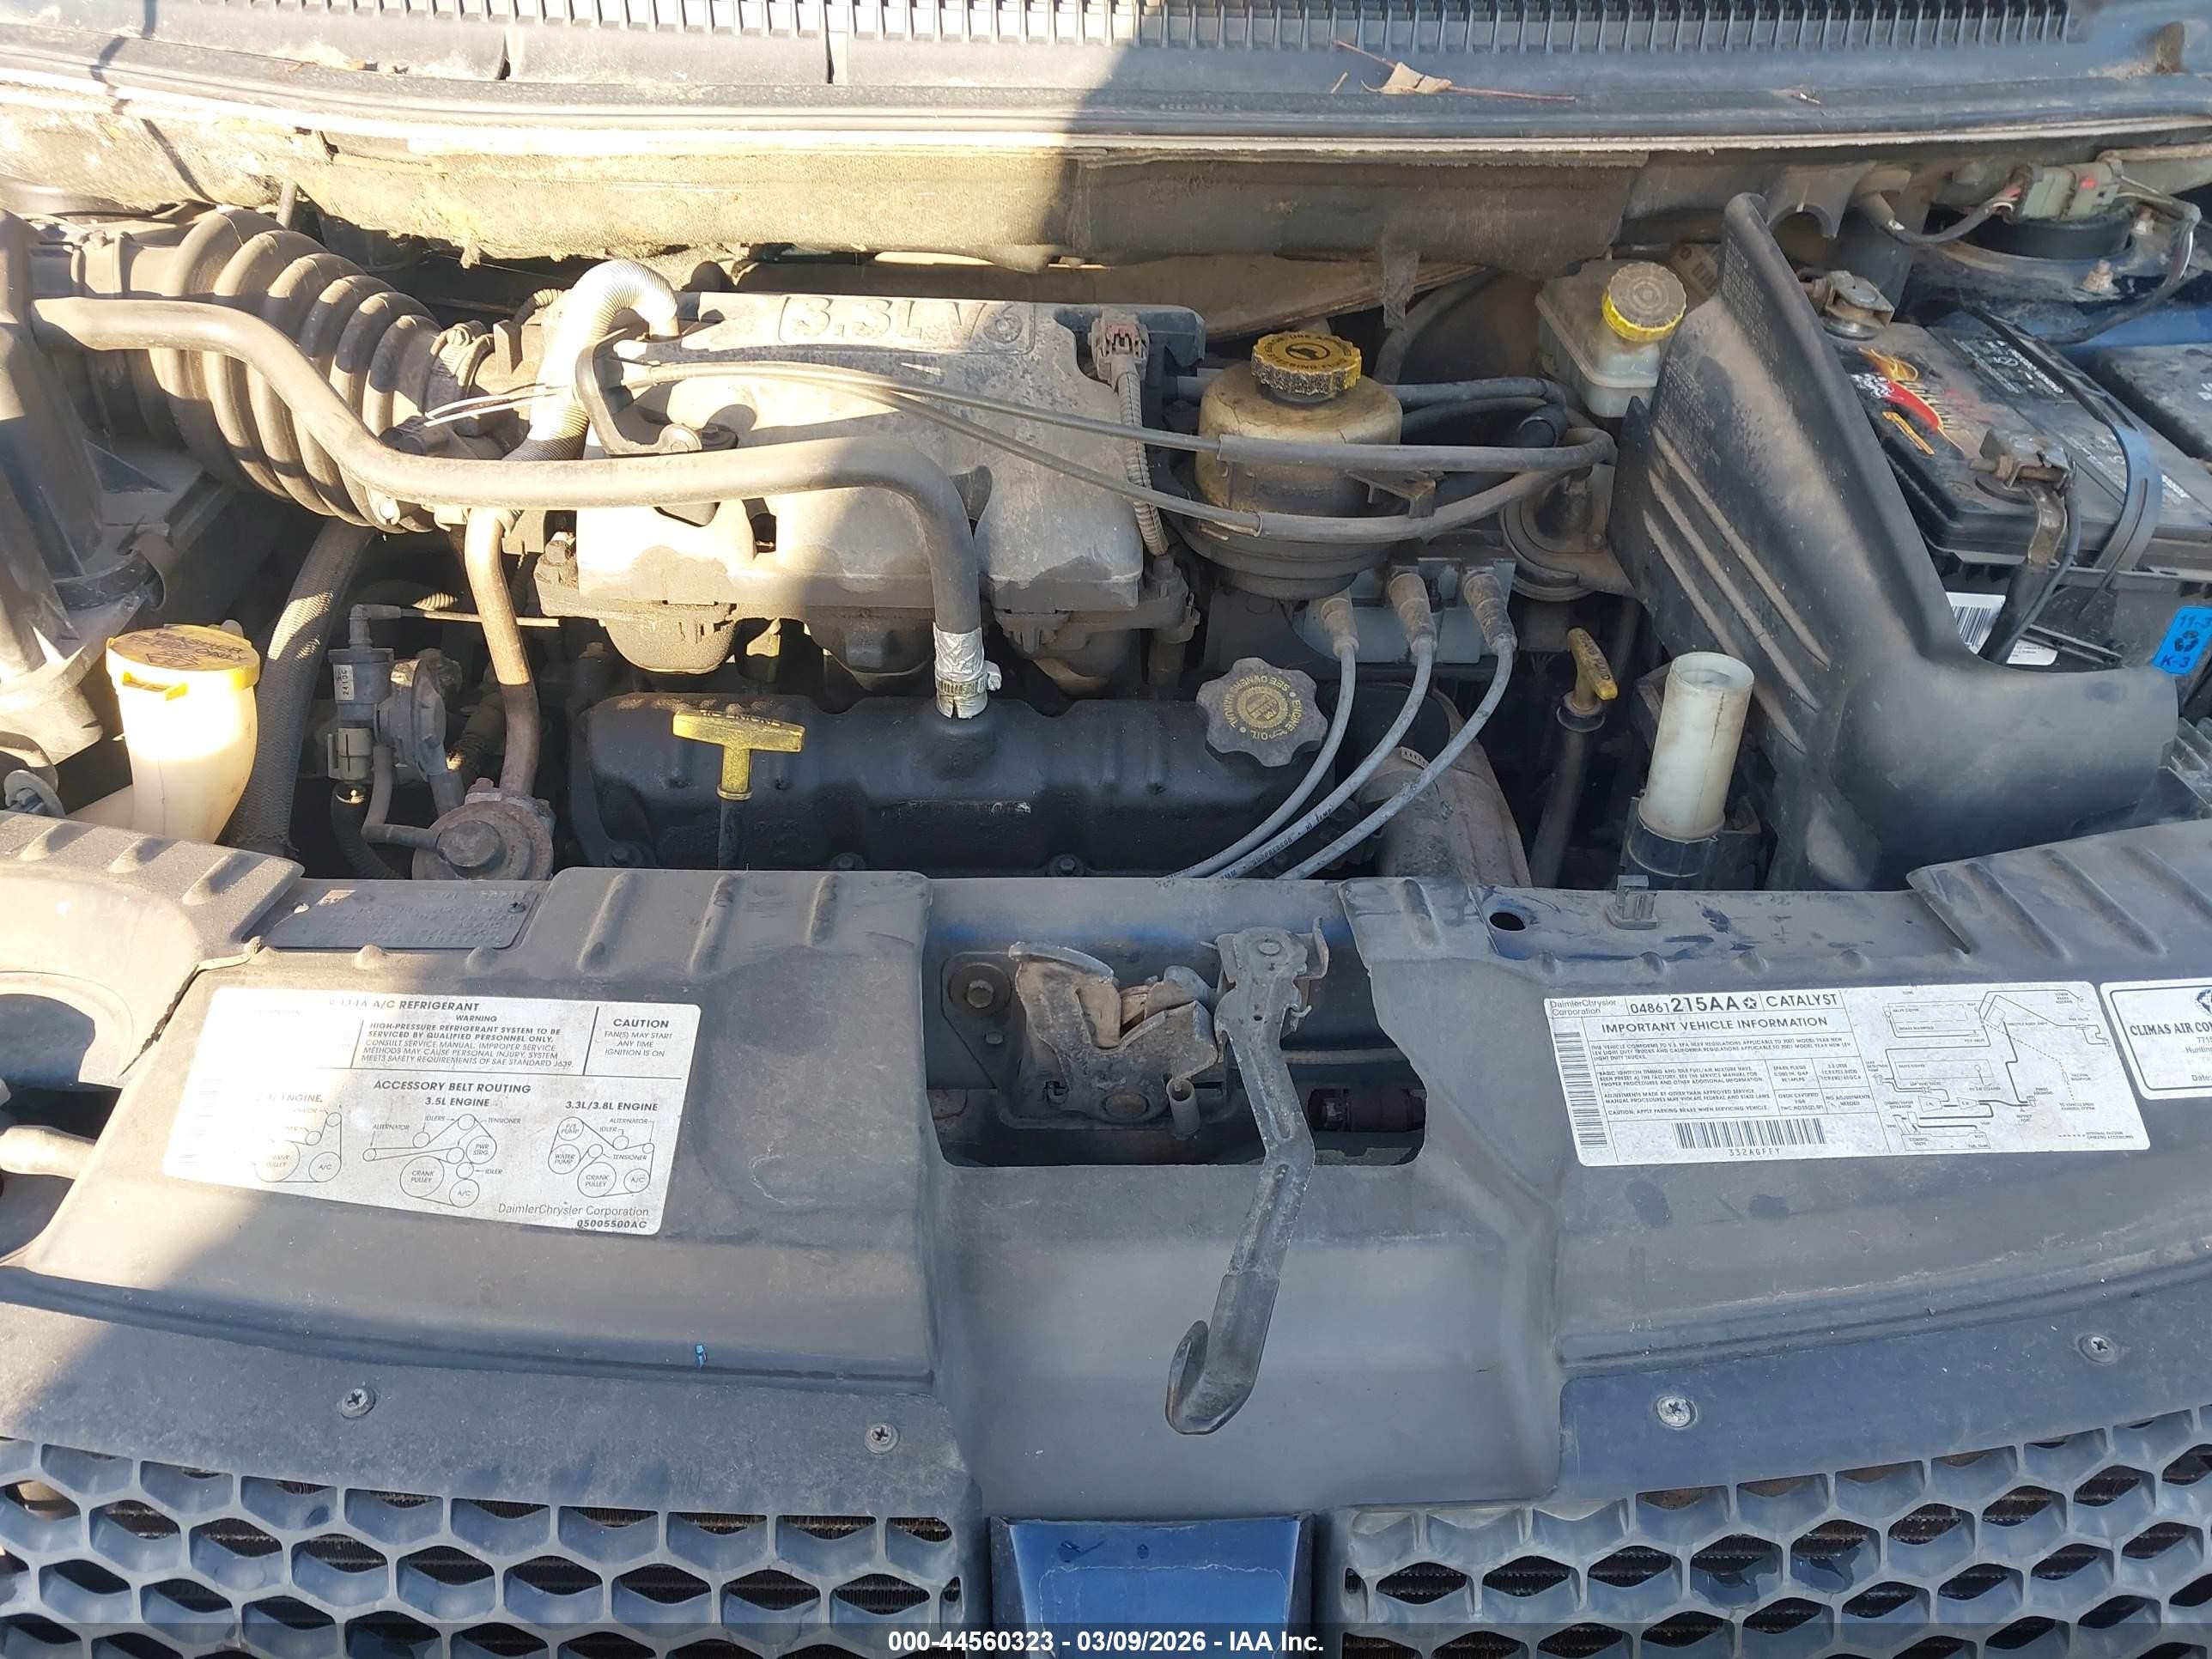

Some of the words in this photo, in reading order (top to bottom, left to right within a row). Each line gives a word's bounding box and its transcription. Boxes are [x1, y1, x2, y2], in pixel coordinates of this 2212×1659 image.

[945, 301, 1024, 344] V6
[2160, 654, 2191, 668] K-3
[1269, 677, 1290, 691] SEE
[1223, 693, 1238, 728] MANUAL
[1285, 700, 1303, 732] ENGINE
[1250, 729, 1268, 741] OIL
[373, 1000, 396, 1009] A/C
[398, 1000, 480, 1012] REFRIGERANT
[1550, 999, 1617, 1009] DaimlerChrysler
[1765, 994, 1838, 1007] CATALYST
[1552, 1006, 1601, 1017] Corporation
[456, 1014, 497, 1023] WARNING
[613, 1018, 670, 1029] CAUTION
[369, 1023, 436, 1031] HIGH-PRESSURE
[439, 1024, 499, 1033] REFRIGERANT
[1601, 1022, 1676, 1033] IMPORTANT
[1680, 1020, 1735, 1030] VEHICLE
[1737, 1017, 1828, 1030] INFORMATION
[2130, 1024, 2171, 1036] CLIMAS
[2174, 1023, 2194, 1034] AIR
[475, 1034, 526, 1042] PERSONNEL
[604, 1030, 629, 1040] FAN(S)
[479, 1042, 521, 1051] IMPROPER
[605, 1048, 642, 1057] IGNITION
[416, 1055, 477, 1064] REQUIREMENTS
[373, 1079, 446, 1091] ACCESSORY
[448, 1081, 474, 1092] BELT
[477, 1082, 532, 1094] ROUTING
[425, 1097, 447, 1106] 3.5L
[450, 1097, 490, 1107] ENGINE
[565, 1101, 614, 1110] 3.3L/3.8L
[617, 1102, 659, 1111] ENGINE
[498, 1202, 583, 1216] DaimlerChrysler
[586, 1206, 649, 1218] Corporation
[576, 1219, 647, 1229] 05005500AC
